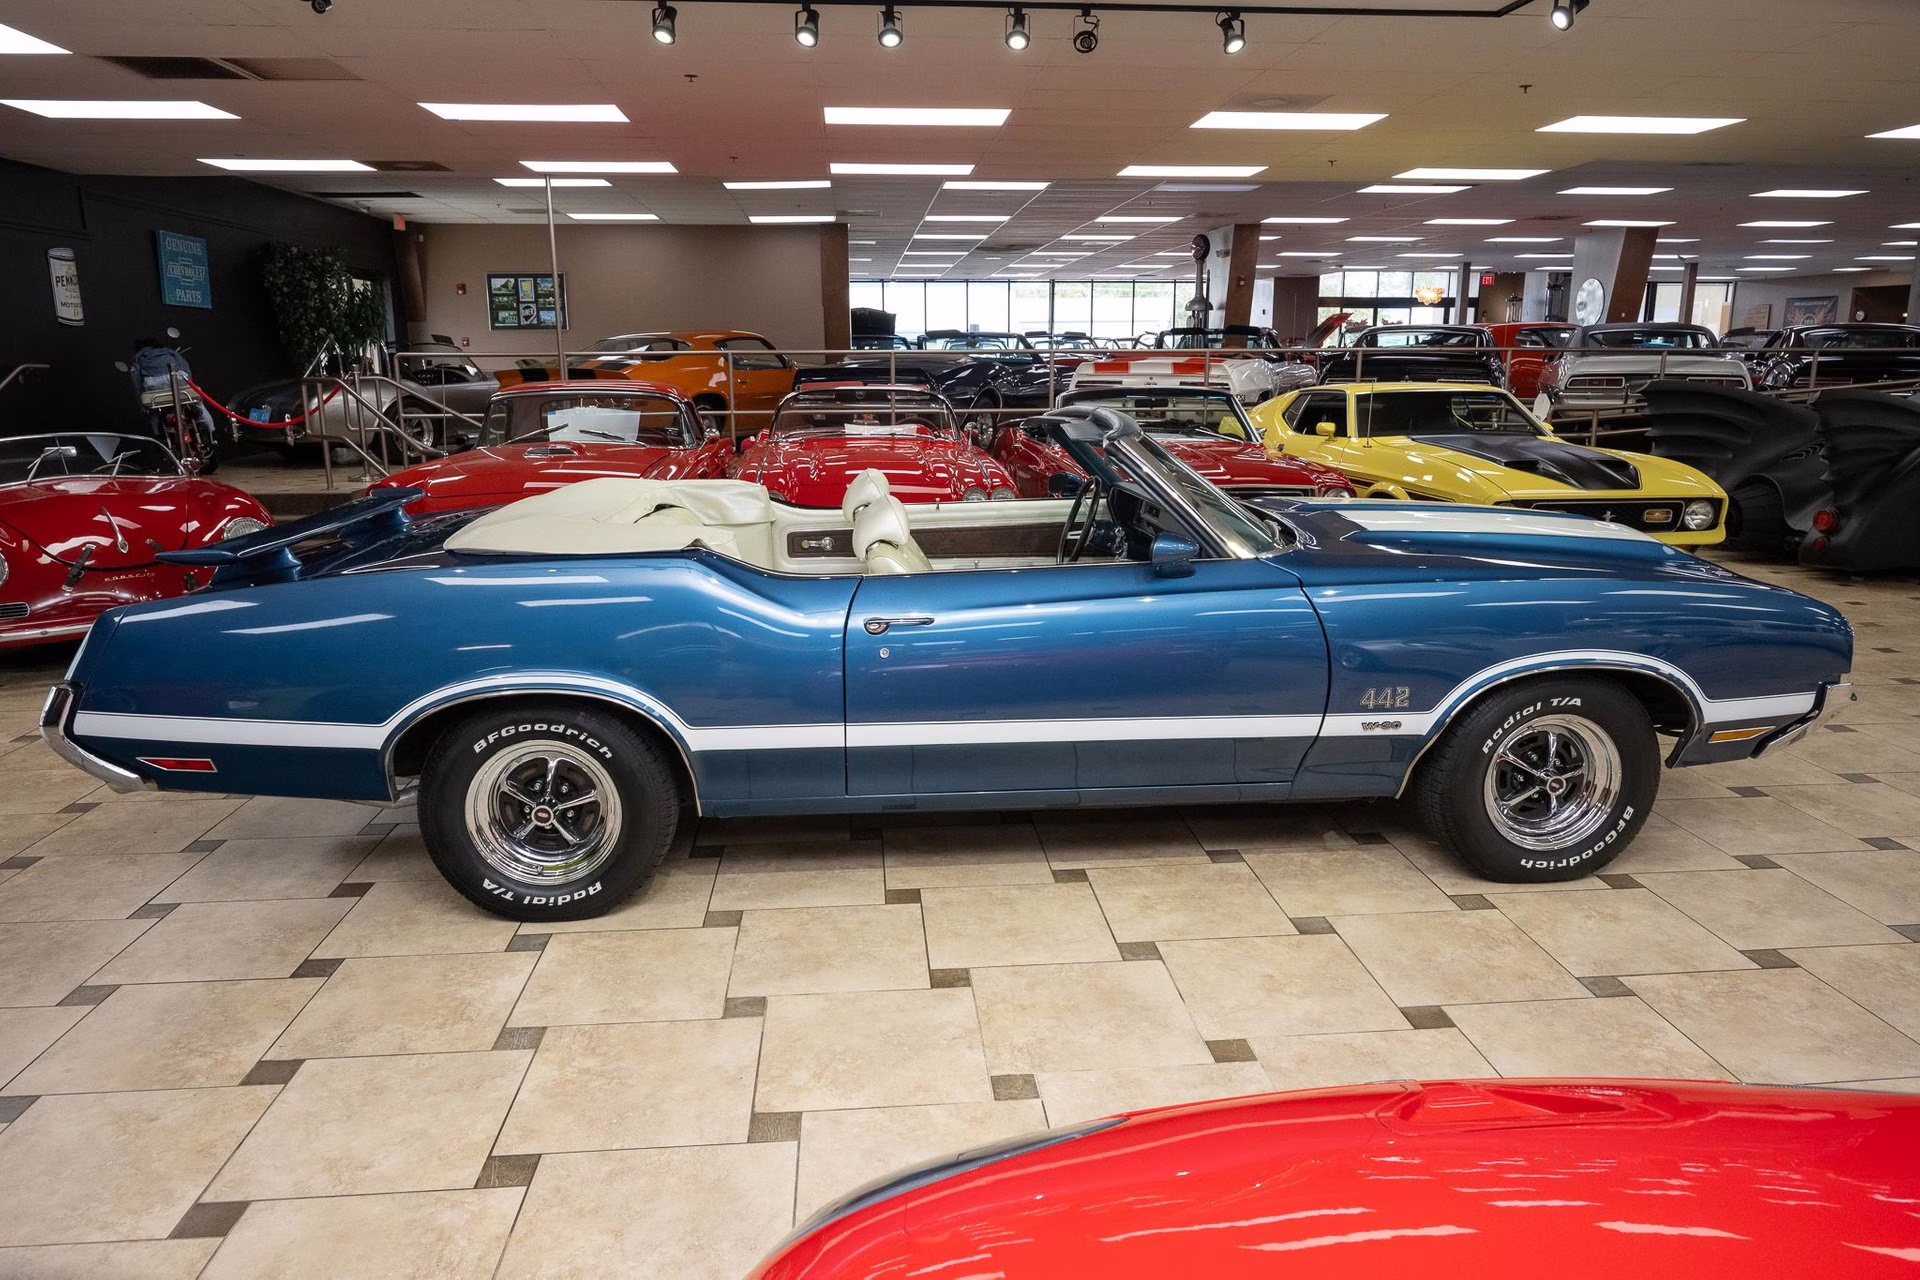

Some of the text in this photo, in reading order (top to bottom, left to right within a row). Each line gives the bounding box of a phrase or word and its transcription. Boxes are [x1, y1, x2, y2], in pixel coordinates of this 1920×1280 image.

[166, 237, 202, 255] GENUINE
[169, 264, 203, 279] CHEVROLET
[175, 288, 202, 303] PARTS
[1360, 686, 1410, 709] 442
[1361, 720, 1402, 731] W-30
[1482, 697, 1582, 754] Radial T/A
[473, 723, 613, 759] BFGoodrich
[1520, 806, 1635, 870] BFGoodrich
[482, 878, 602, 906] Radial T/A
